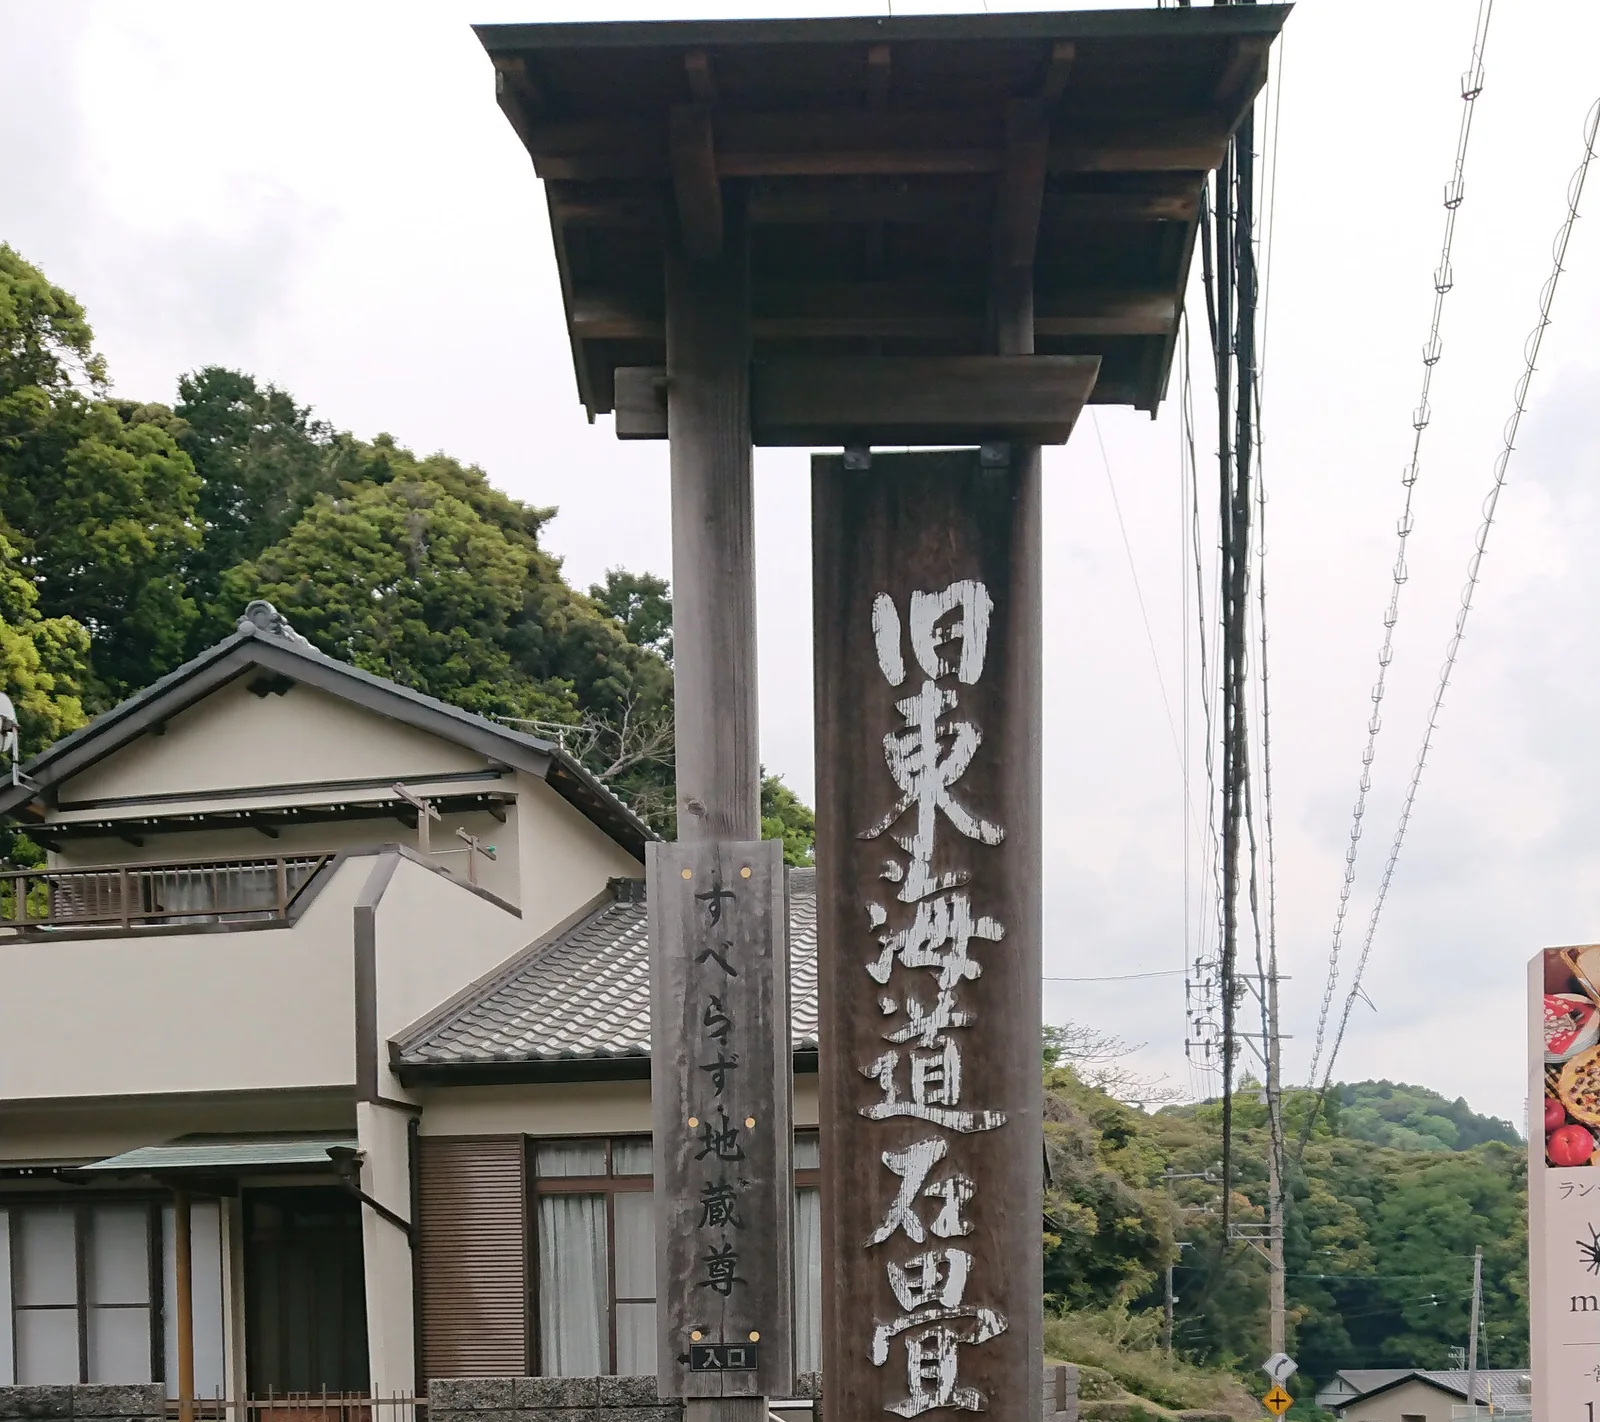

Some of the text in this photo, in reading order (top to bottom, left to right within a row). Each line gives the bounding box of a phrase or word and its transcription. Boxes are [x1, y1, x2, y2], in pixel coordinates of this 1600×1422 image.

[694, 882, 749, 1297] すべらず地蔵尊
[1559, 1181, 1600, 1201] ラン
[702, 1348, 746, 1368] 入口
